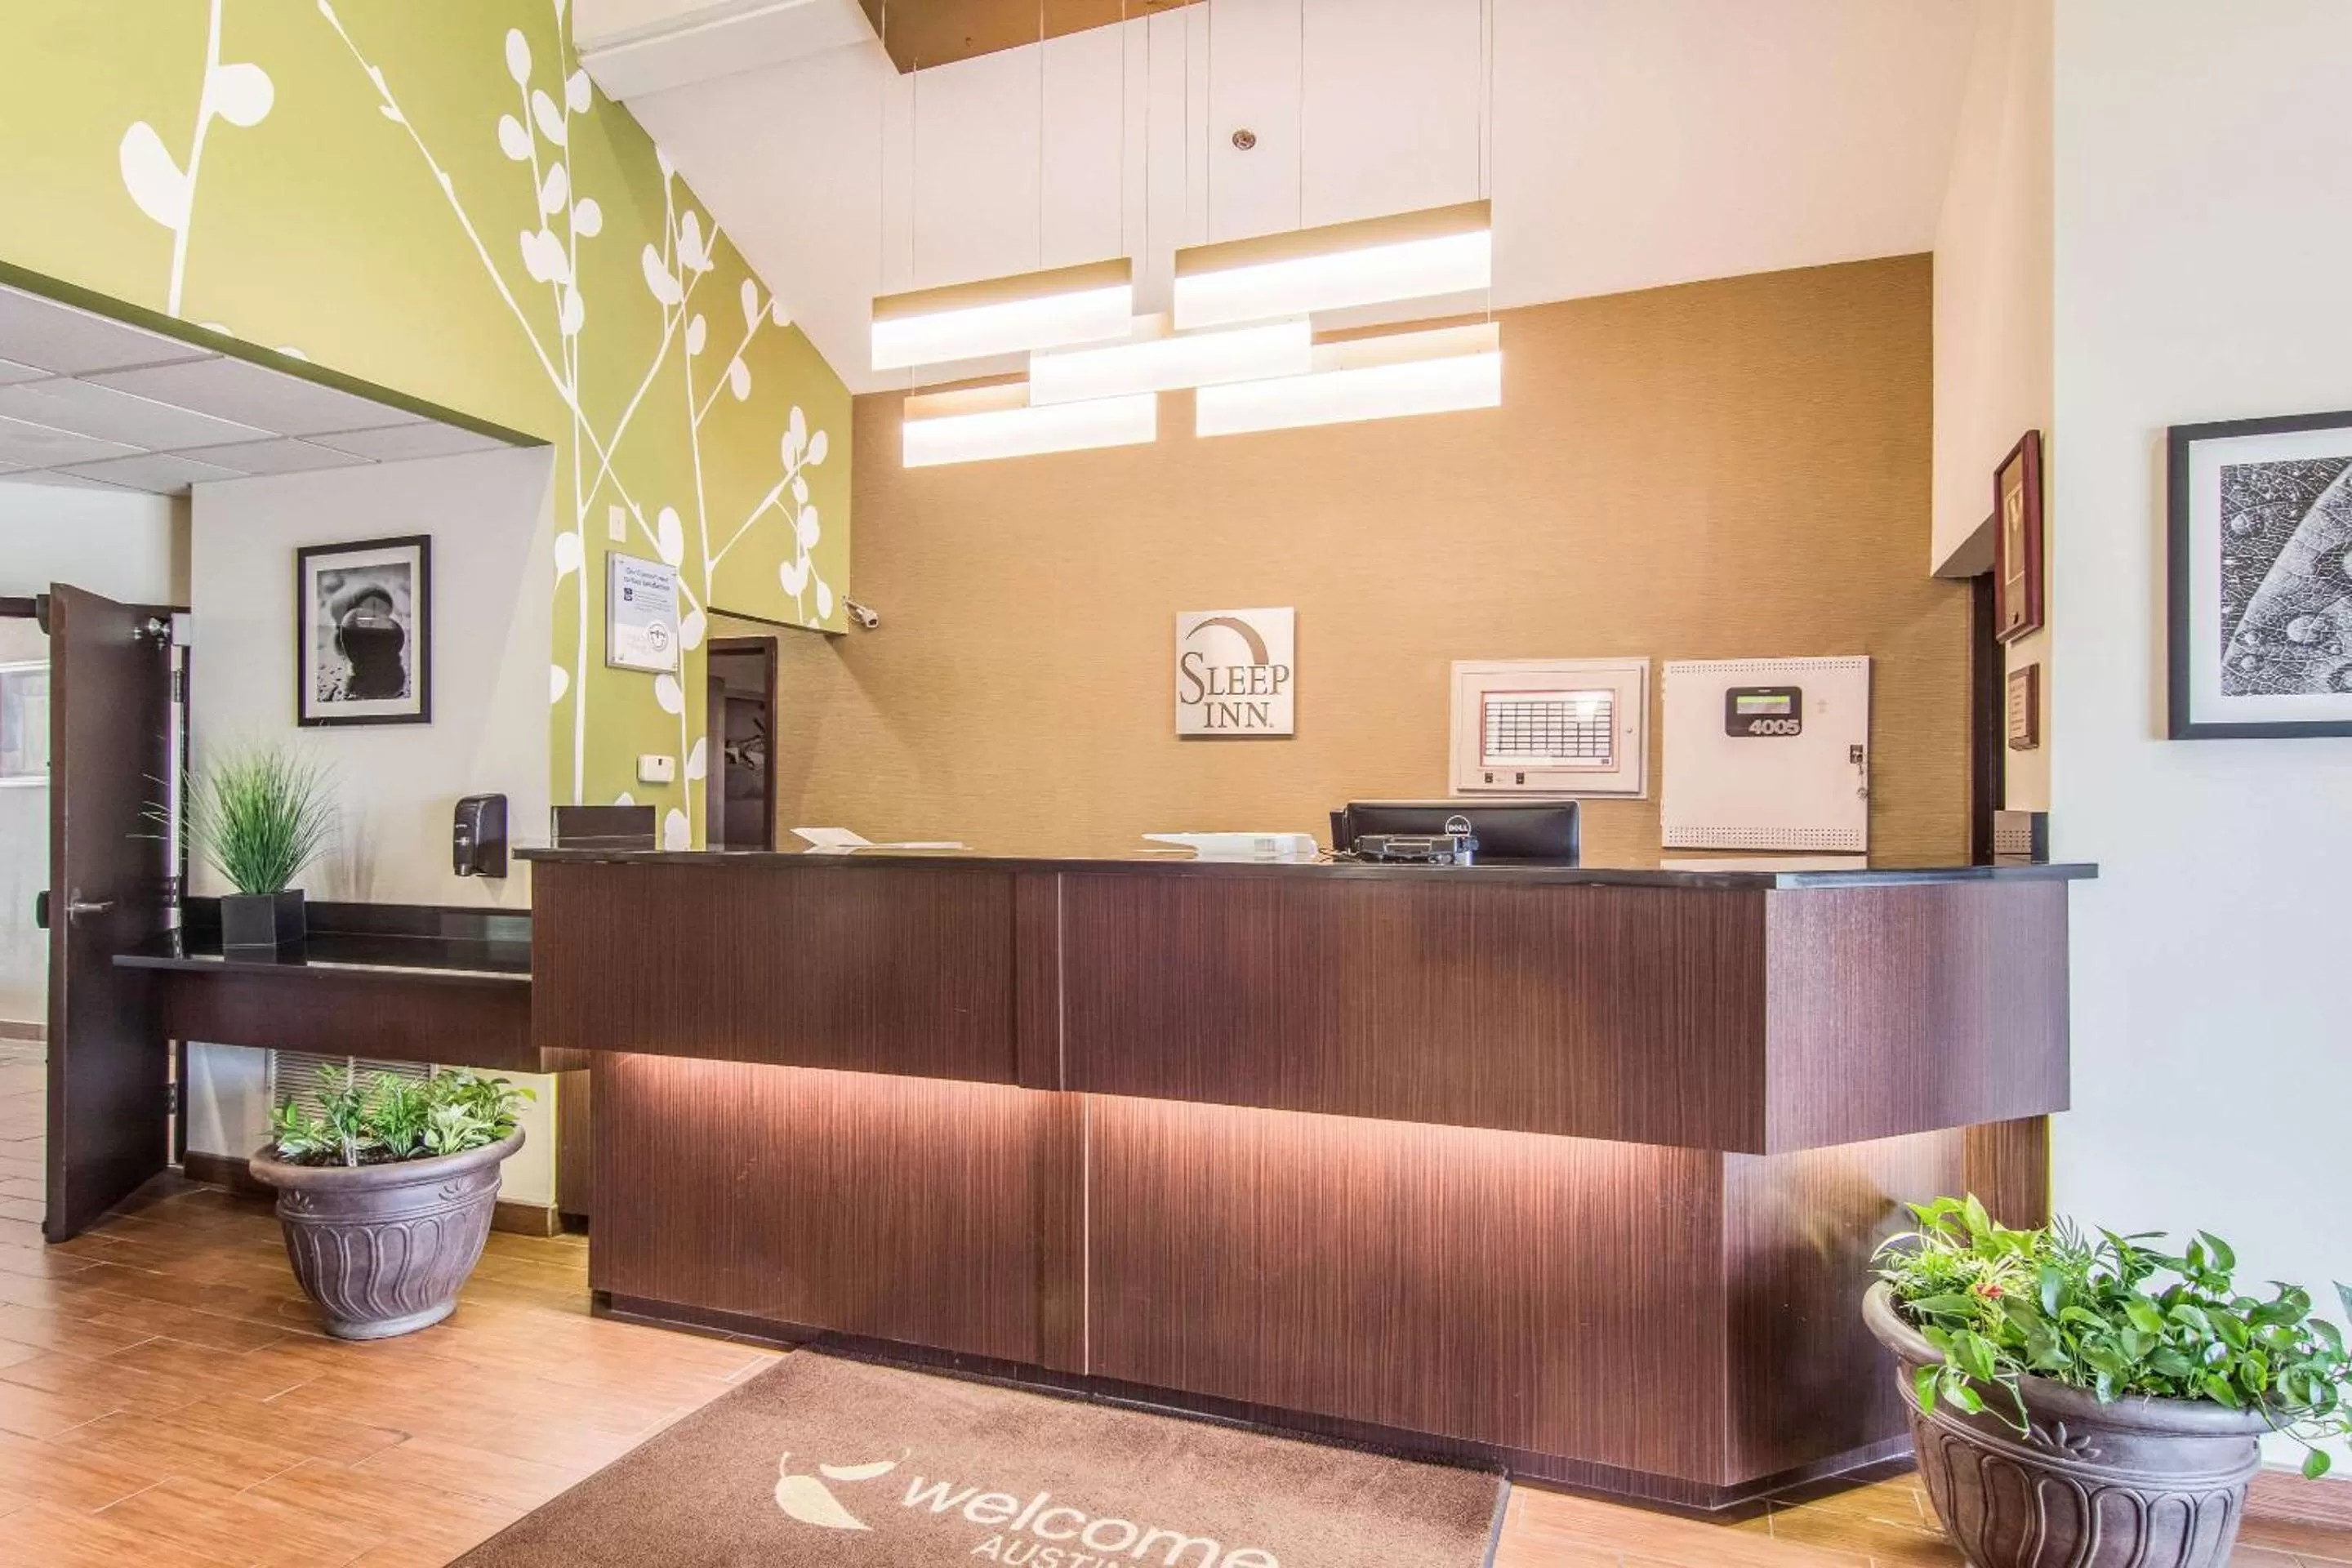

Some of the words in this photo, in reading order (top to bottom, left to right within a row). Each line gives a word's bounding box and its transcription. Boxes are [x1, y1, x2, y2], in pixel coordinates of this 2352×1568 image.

[1179, 652, 1290, 705] SLEEP
[1748, 719, 1801, 735] 4005
[902, 1476, 1280, 1568] welcome
[969, 1535, 1141, 1568] AUST
